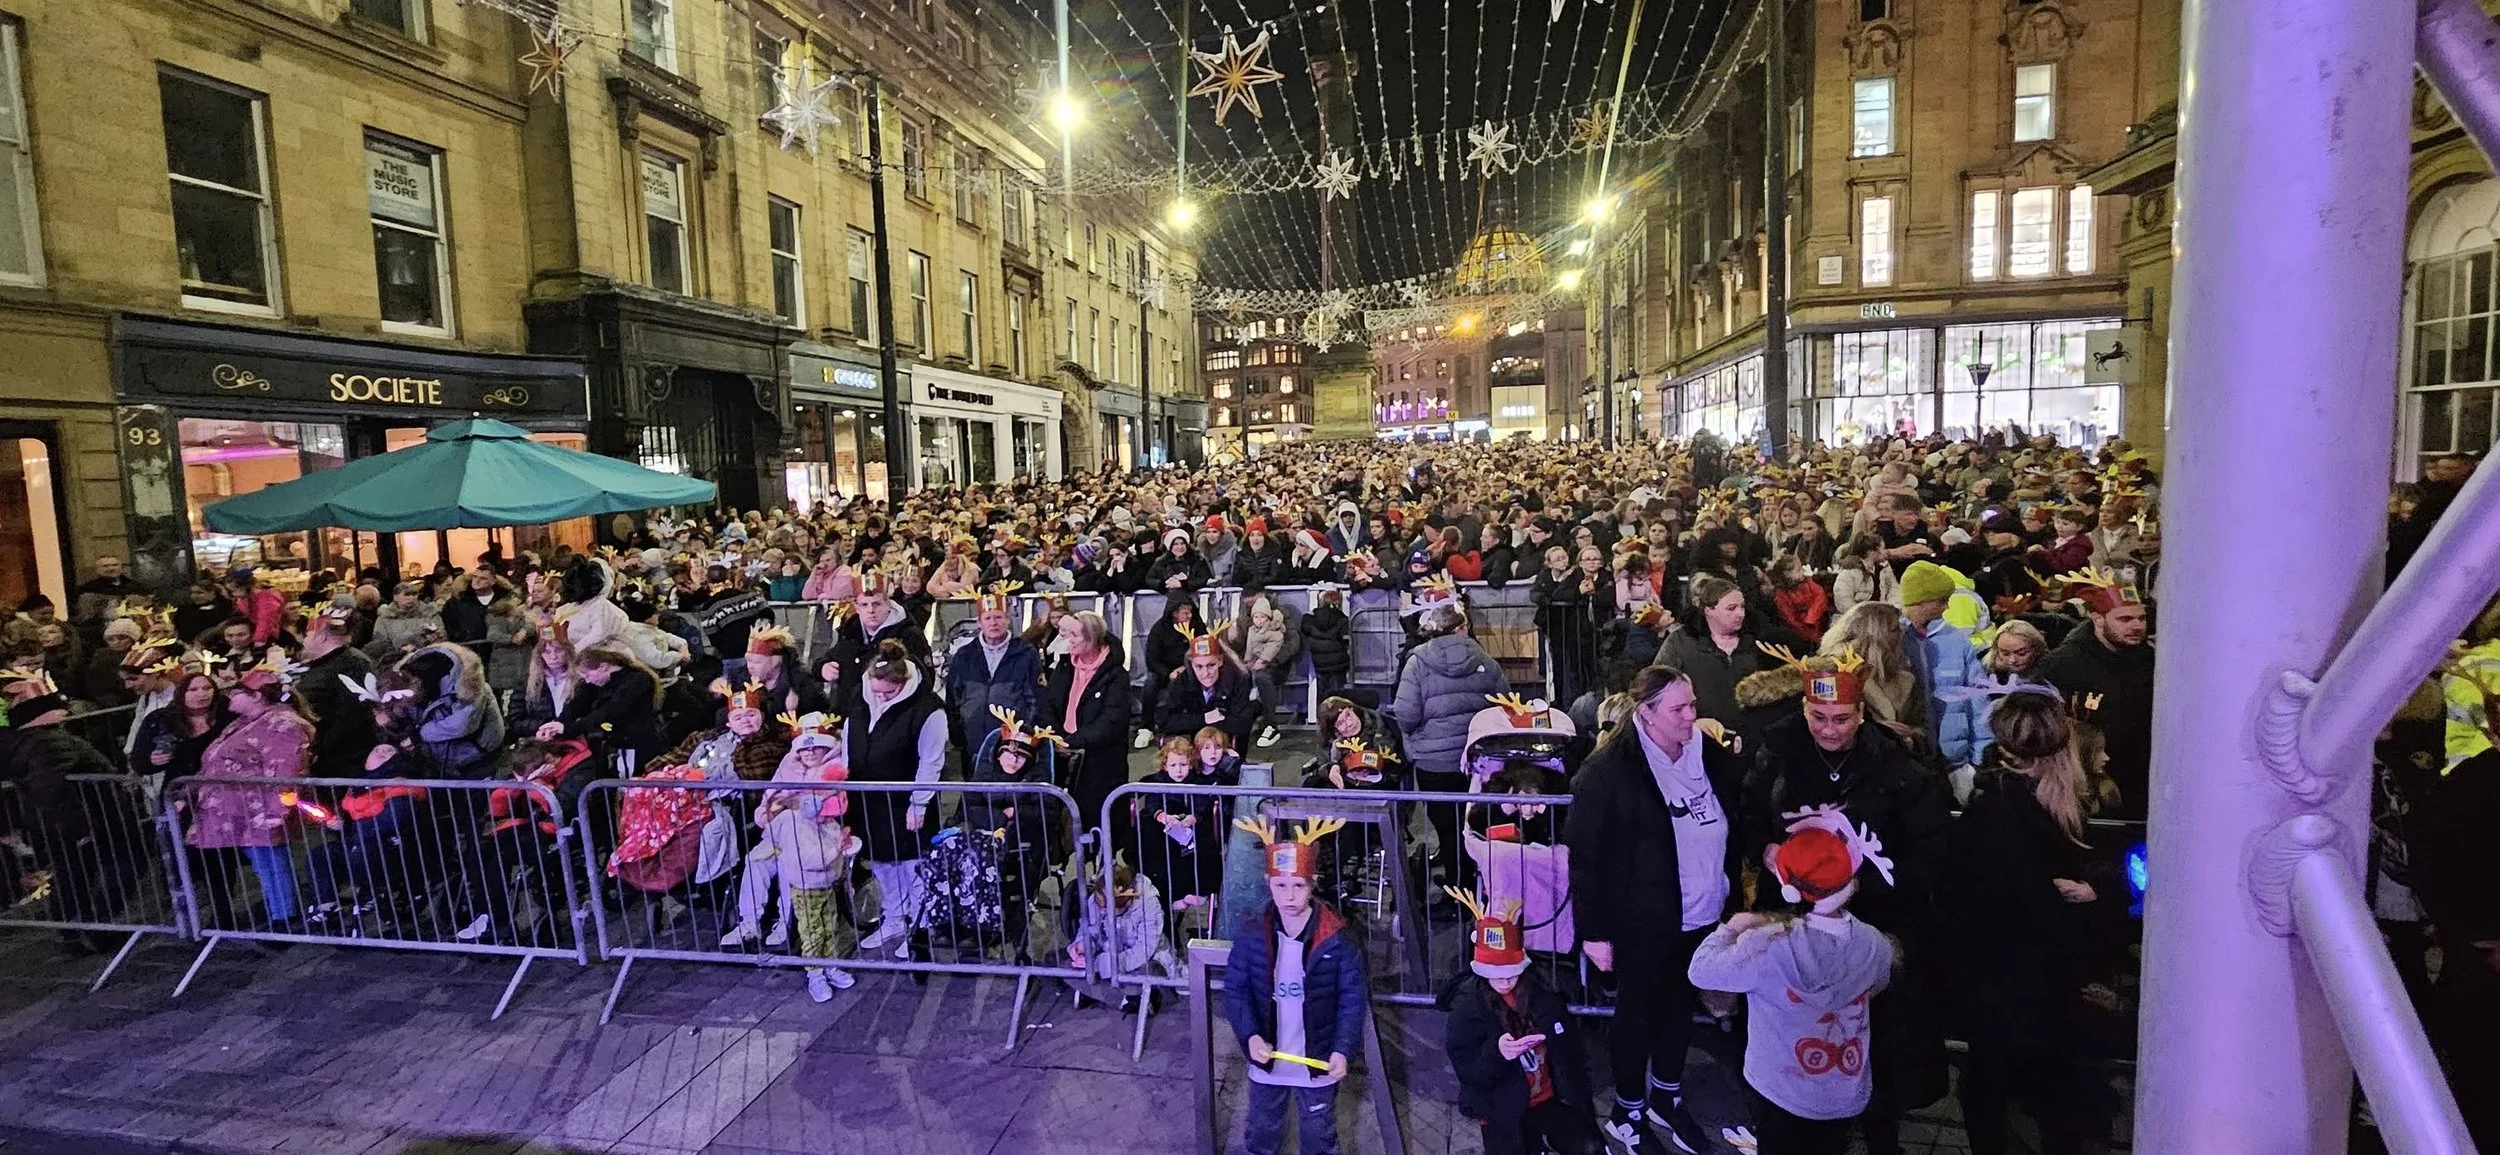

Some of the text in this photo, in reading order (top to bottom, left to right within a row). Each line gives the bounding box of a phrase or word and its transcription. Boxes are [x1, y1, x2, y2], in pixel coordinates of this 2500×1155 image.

[381, 159, 408, 175] THE
[373, 168, 418, 189] MUSIC
[374, 180, 419, 201] STORE
[330, 373, 443, 405] SOCIÉTÉ
[128, 427, 162, 446] 93
[1278, 982, 1301, 998] se
